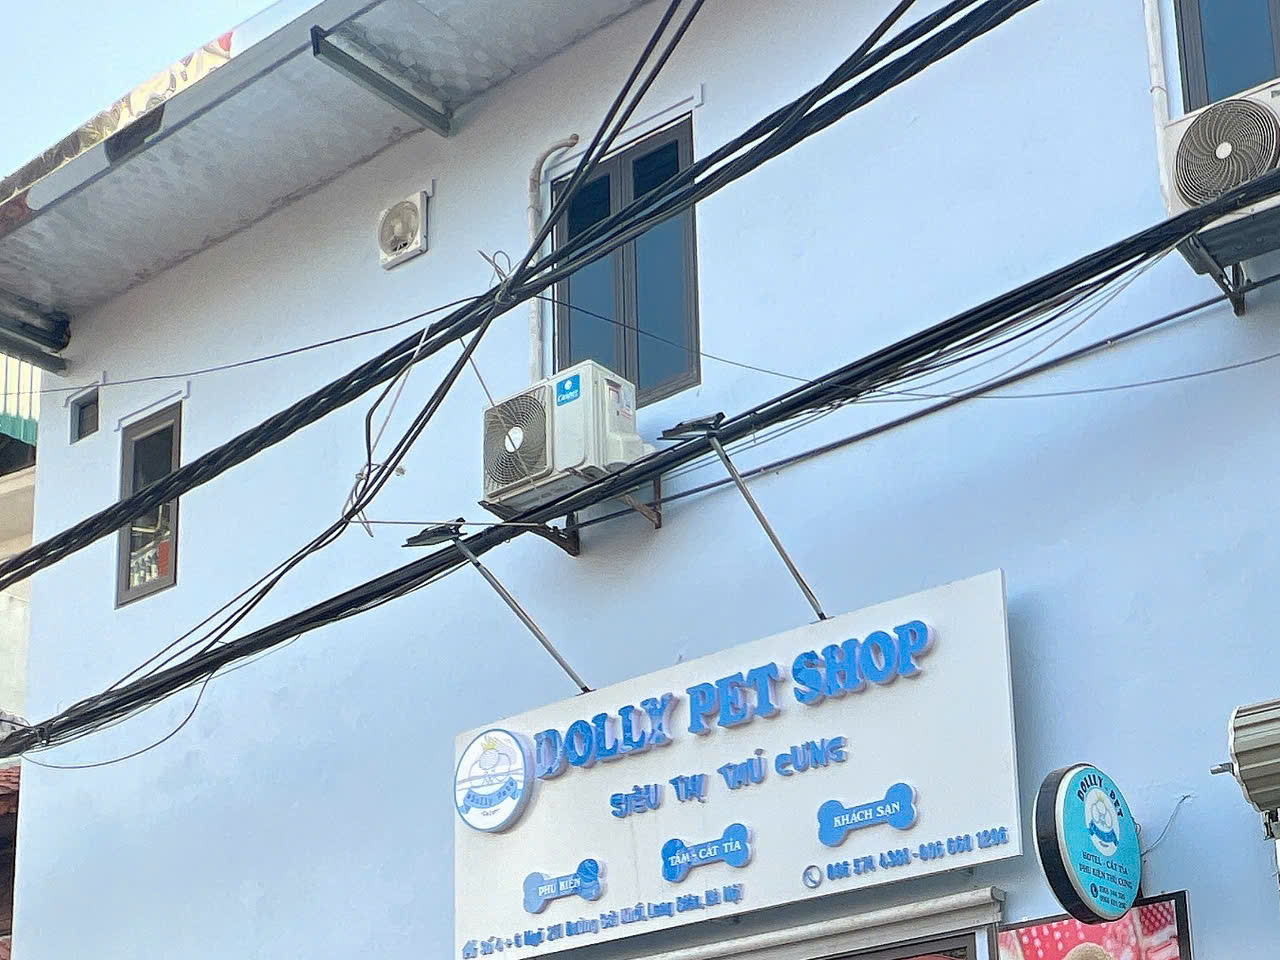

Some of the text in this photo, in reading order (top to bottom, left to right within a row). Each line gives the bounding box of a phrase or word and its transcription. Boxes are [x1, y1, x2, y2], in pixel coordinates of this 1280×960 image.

[534, 620, 935, 780] DOLLY PET SHOP
[833, 806, 873, 828] KHÁCH
